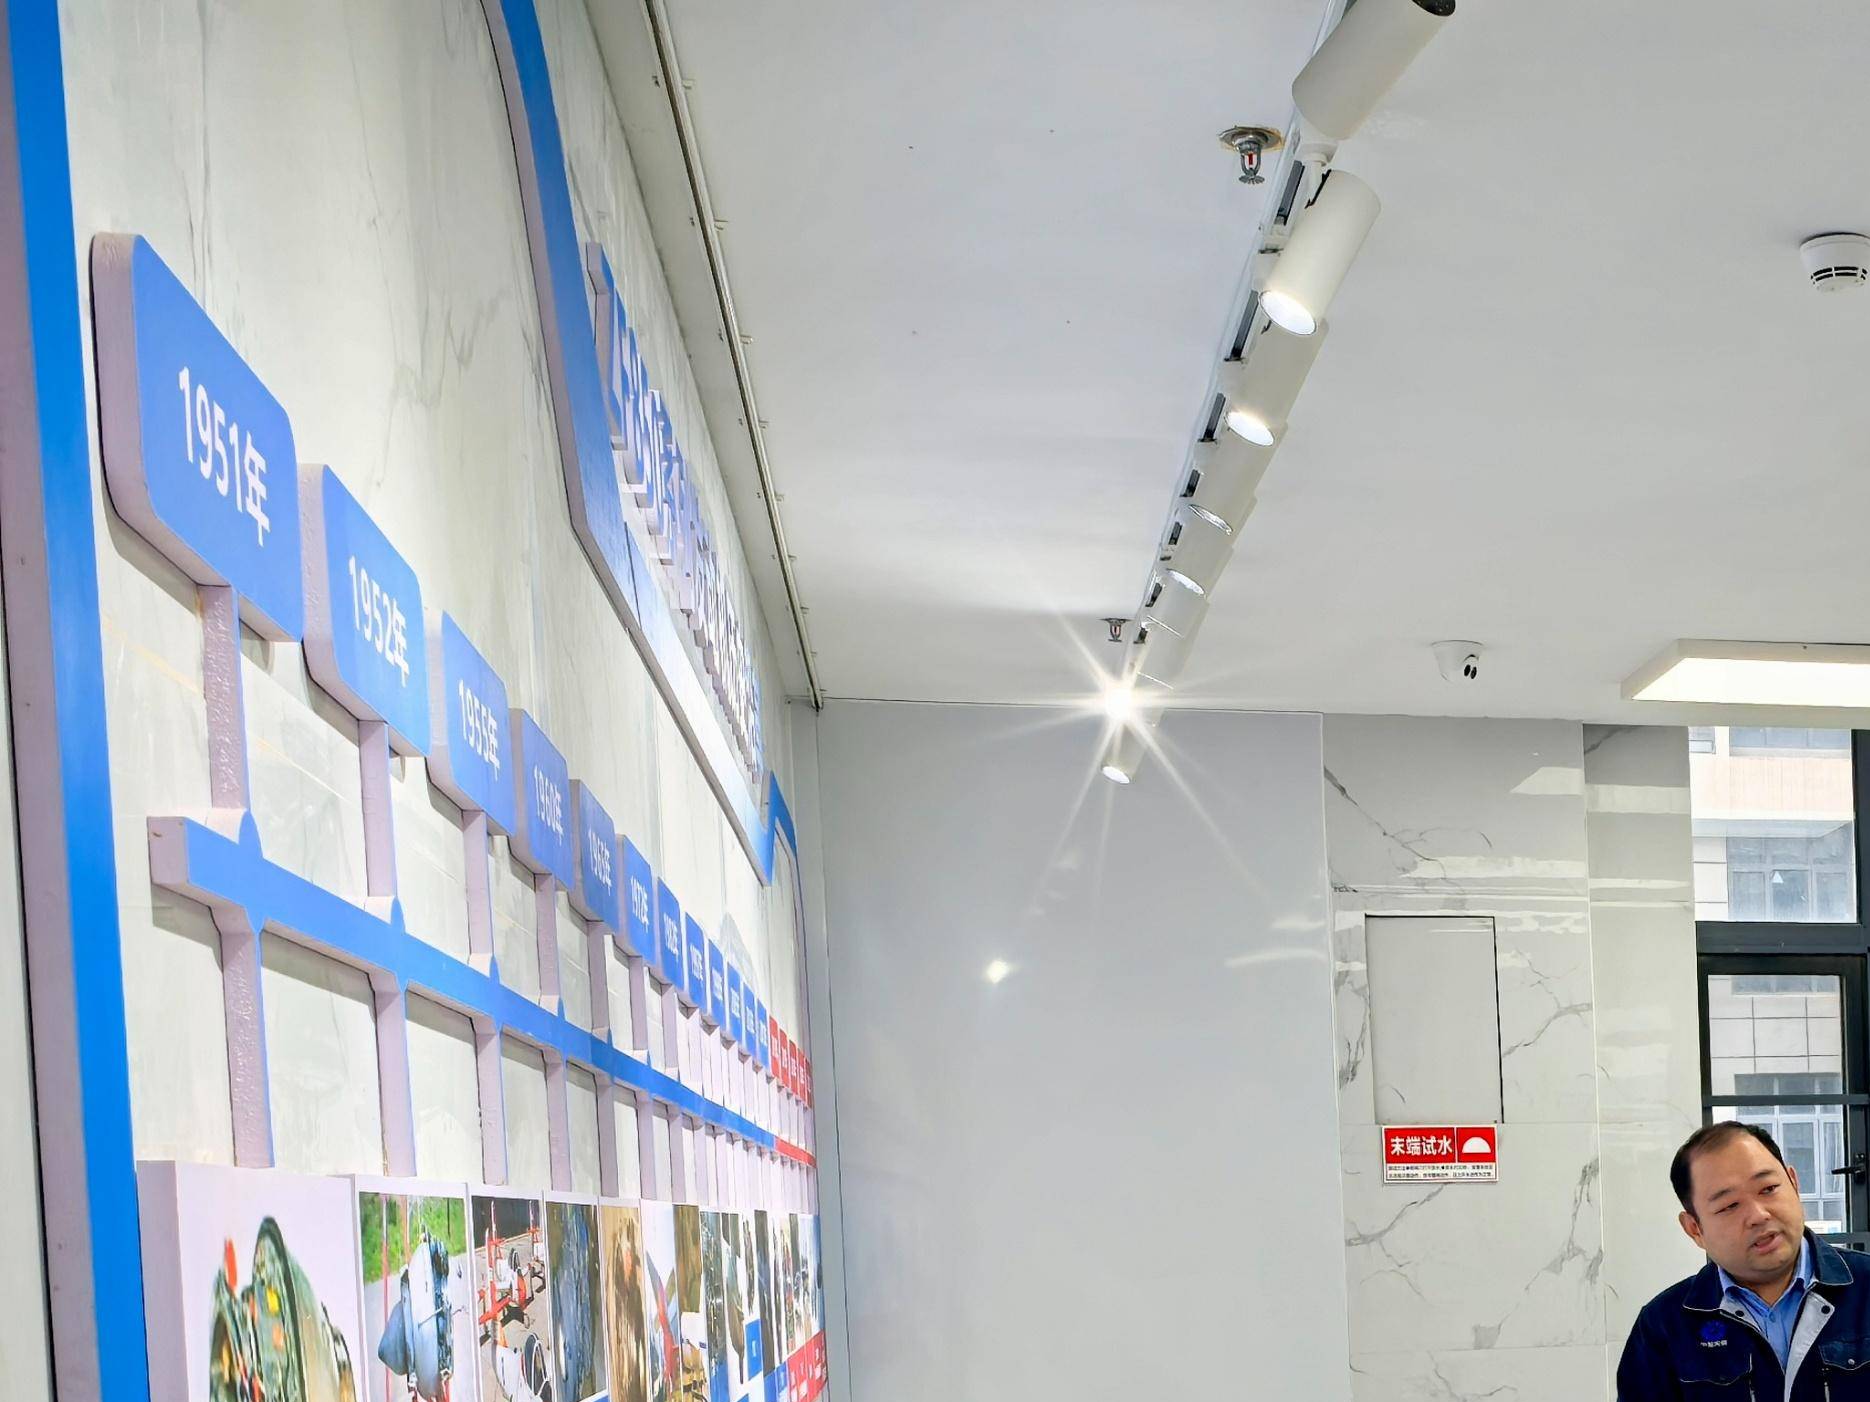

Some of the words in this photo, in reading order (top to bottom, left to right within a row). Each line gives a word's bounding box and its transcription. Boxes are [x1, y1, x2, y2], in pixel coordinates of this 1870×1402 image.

[179, 367, 271, 547] 1951年
[348, 557, 410, 687] 1952年
[459, 680, 500, 781] 1955年
[534, 766, 564, 846] 1960年
[1390, 1135, 1453, 1156] 末端试水
